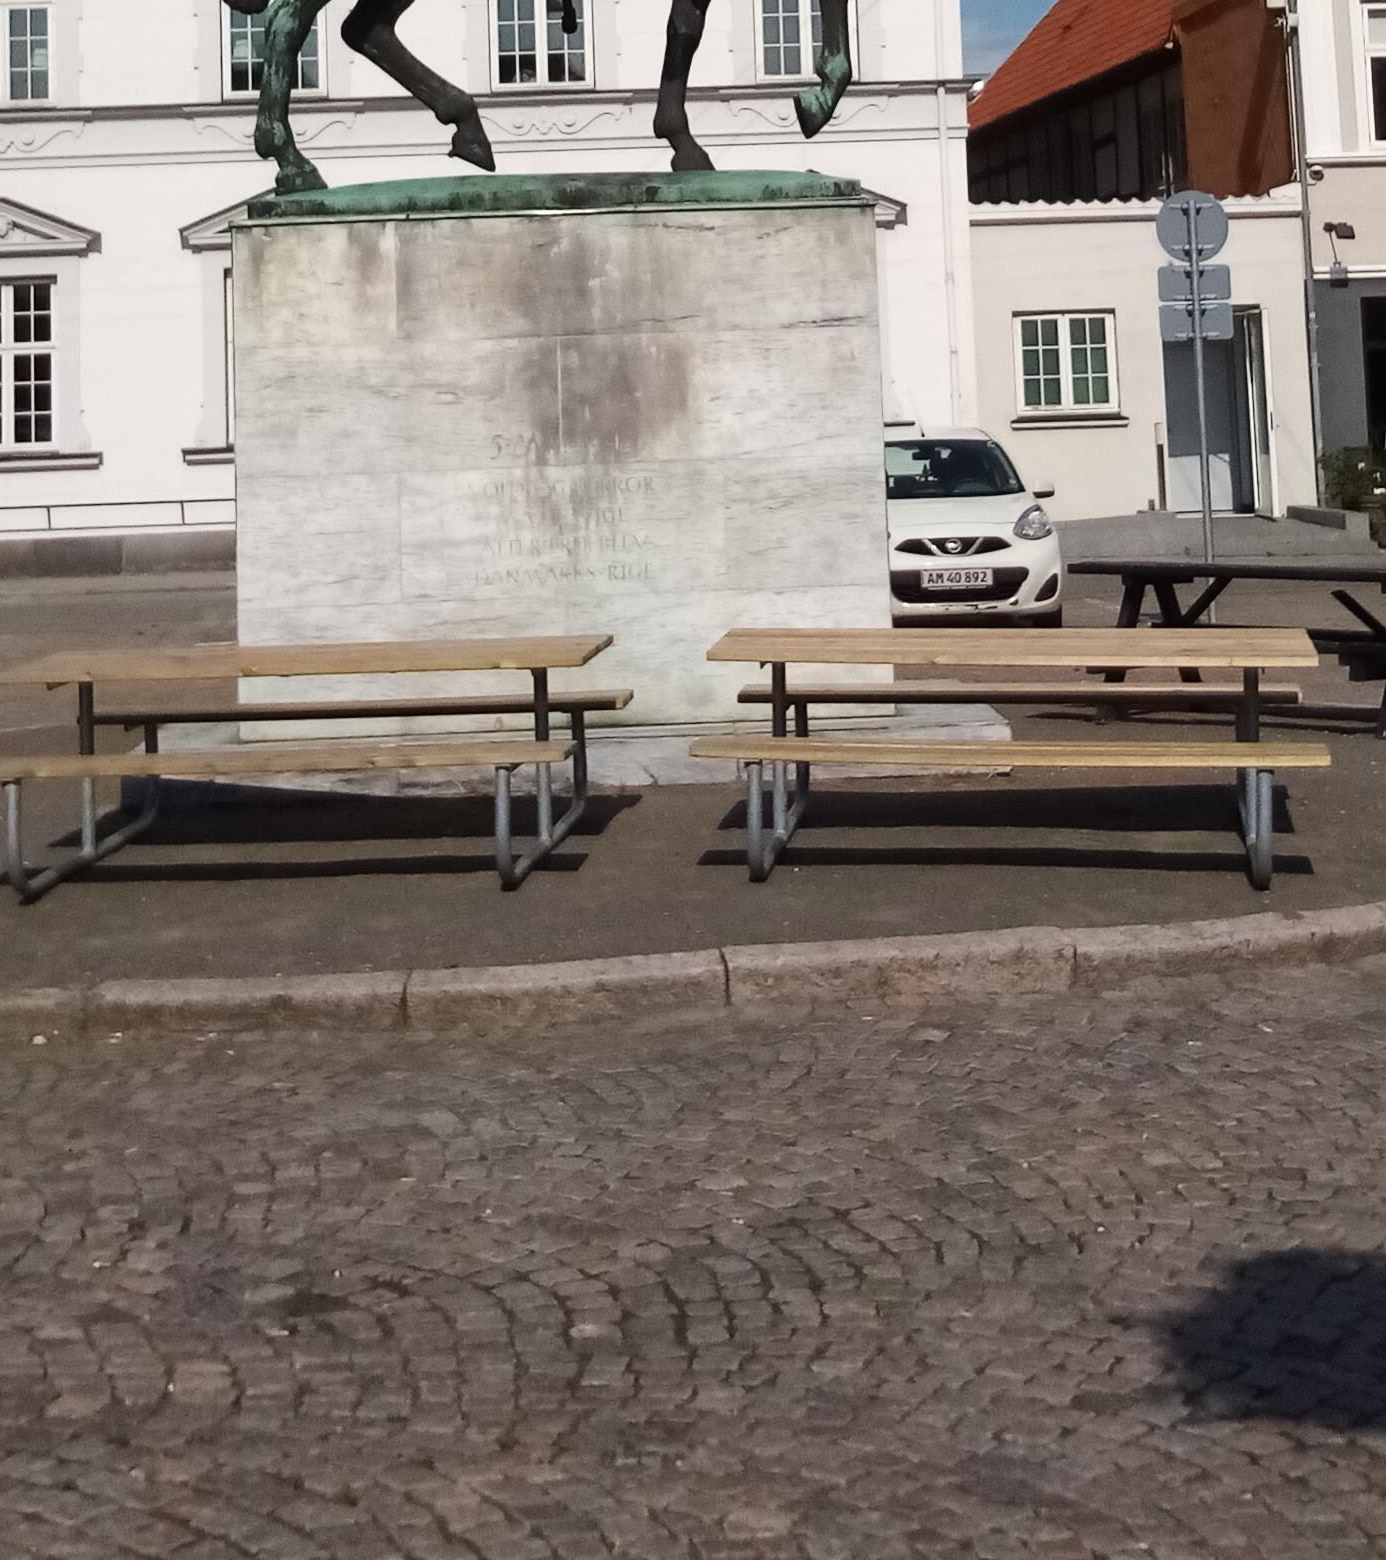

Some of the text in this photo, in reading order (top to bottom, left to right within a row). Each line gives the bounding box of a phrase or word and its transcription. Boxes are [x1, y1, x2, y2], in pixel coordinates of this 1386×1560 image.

[927, 570, 987, 584] AM 40 892
